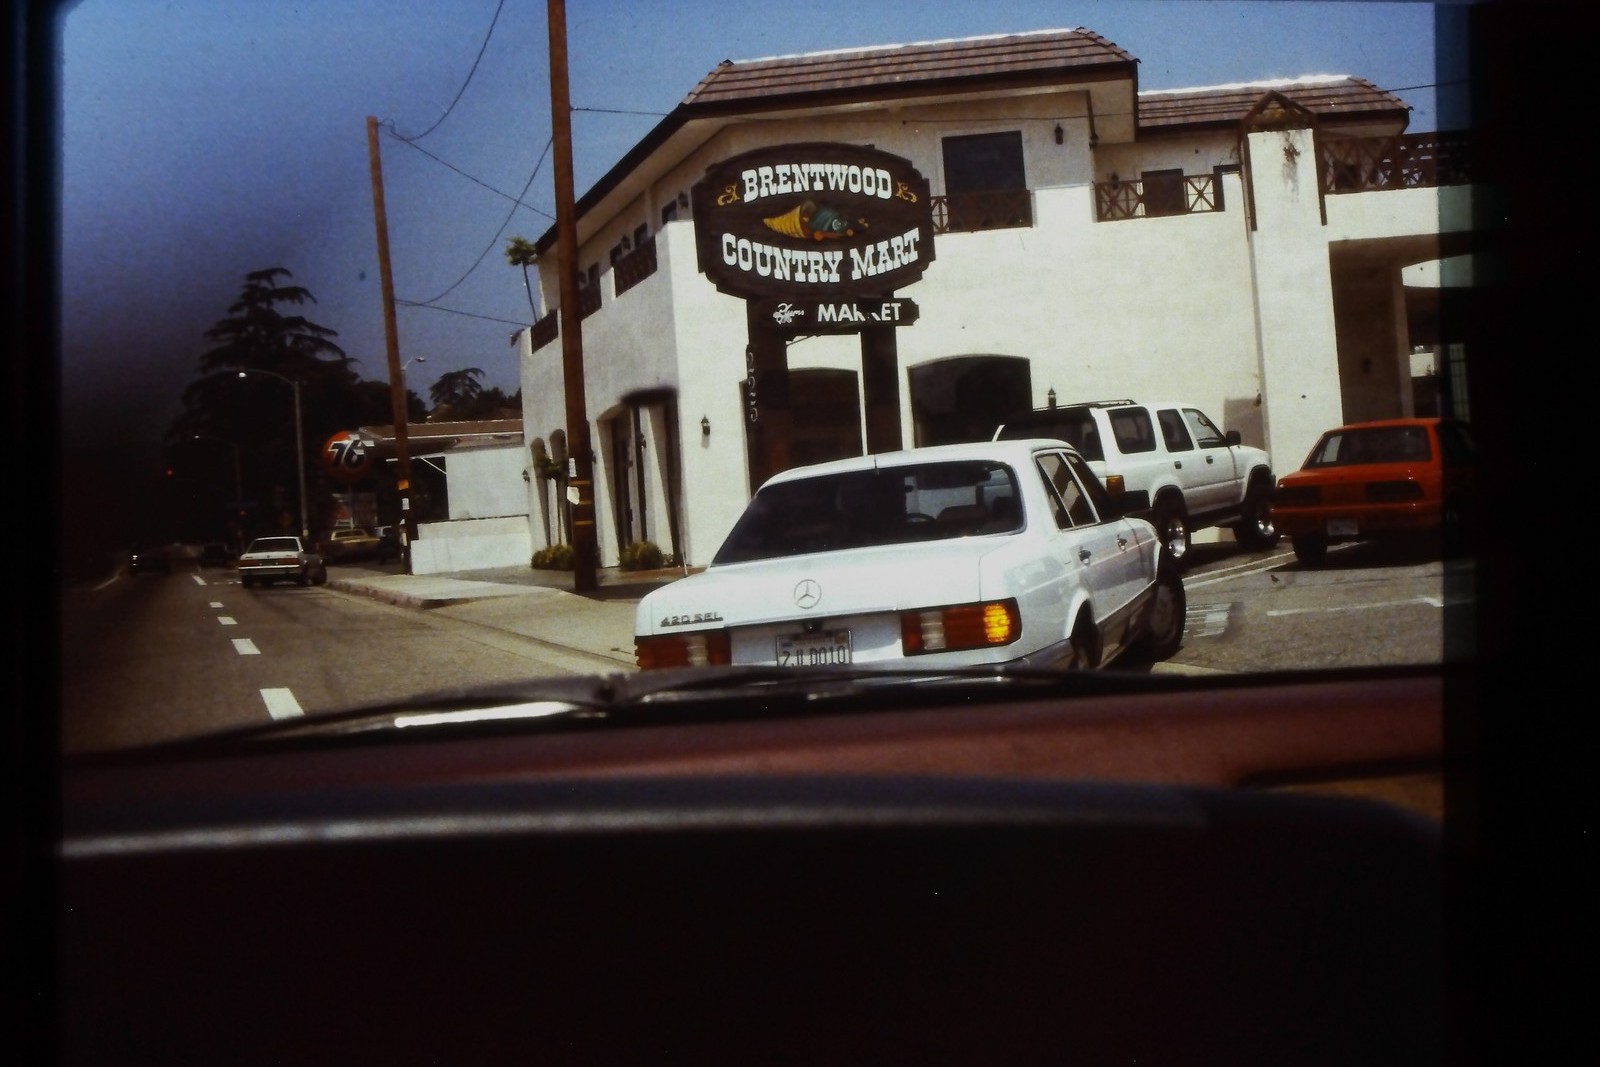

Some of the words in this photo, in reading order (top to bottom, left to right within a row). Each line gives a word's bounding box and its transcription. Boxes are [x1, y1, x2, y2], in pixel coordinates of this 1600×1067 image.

[741, 163, 892, 202] BRENTWOOD
[722, 233, 843, 283] COUNTRY
[850, 227, 920, 281] MART
[328, 437, 366, 470] 76
[660, 614, 690, 627] 420
[694, 612, 724, 624] SEL
